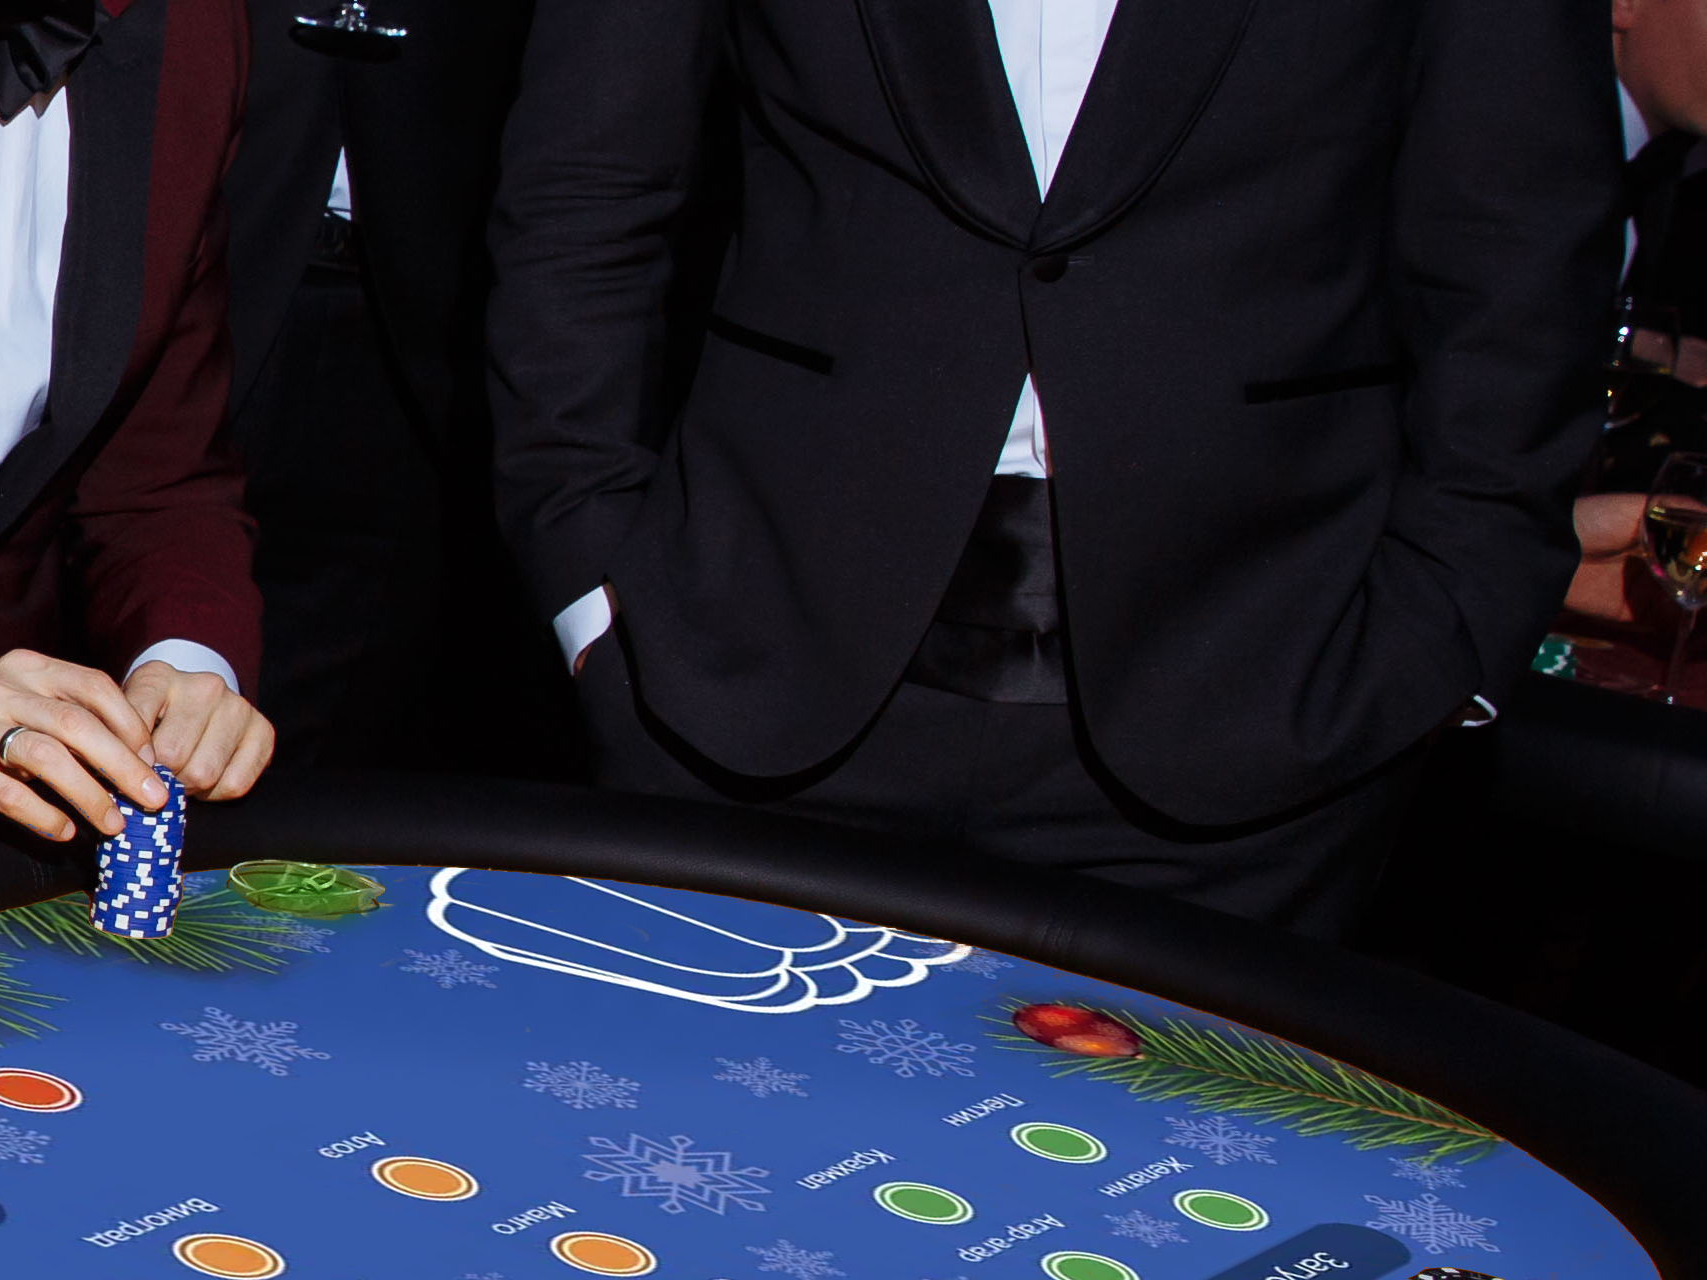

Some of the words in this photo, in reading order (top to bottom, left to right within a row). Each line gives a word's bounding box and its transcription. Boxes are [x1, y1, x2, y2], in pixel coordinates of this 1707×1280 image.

[942, 1093, 1025, 1127] Пектин
[318, 1131, 384, 1159] Алоэ
[796, 1148, 895, 1190] Крахмал
[1099, 1156, 1194, 1198] Желатин
[82, 1197, 220, 1248] Виноград
[491, 1201, 577, 1235] Манго
[957, 1213, 1065, 1264] Агар-агар
